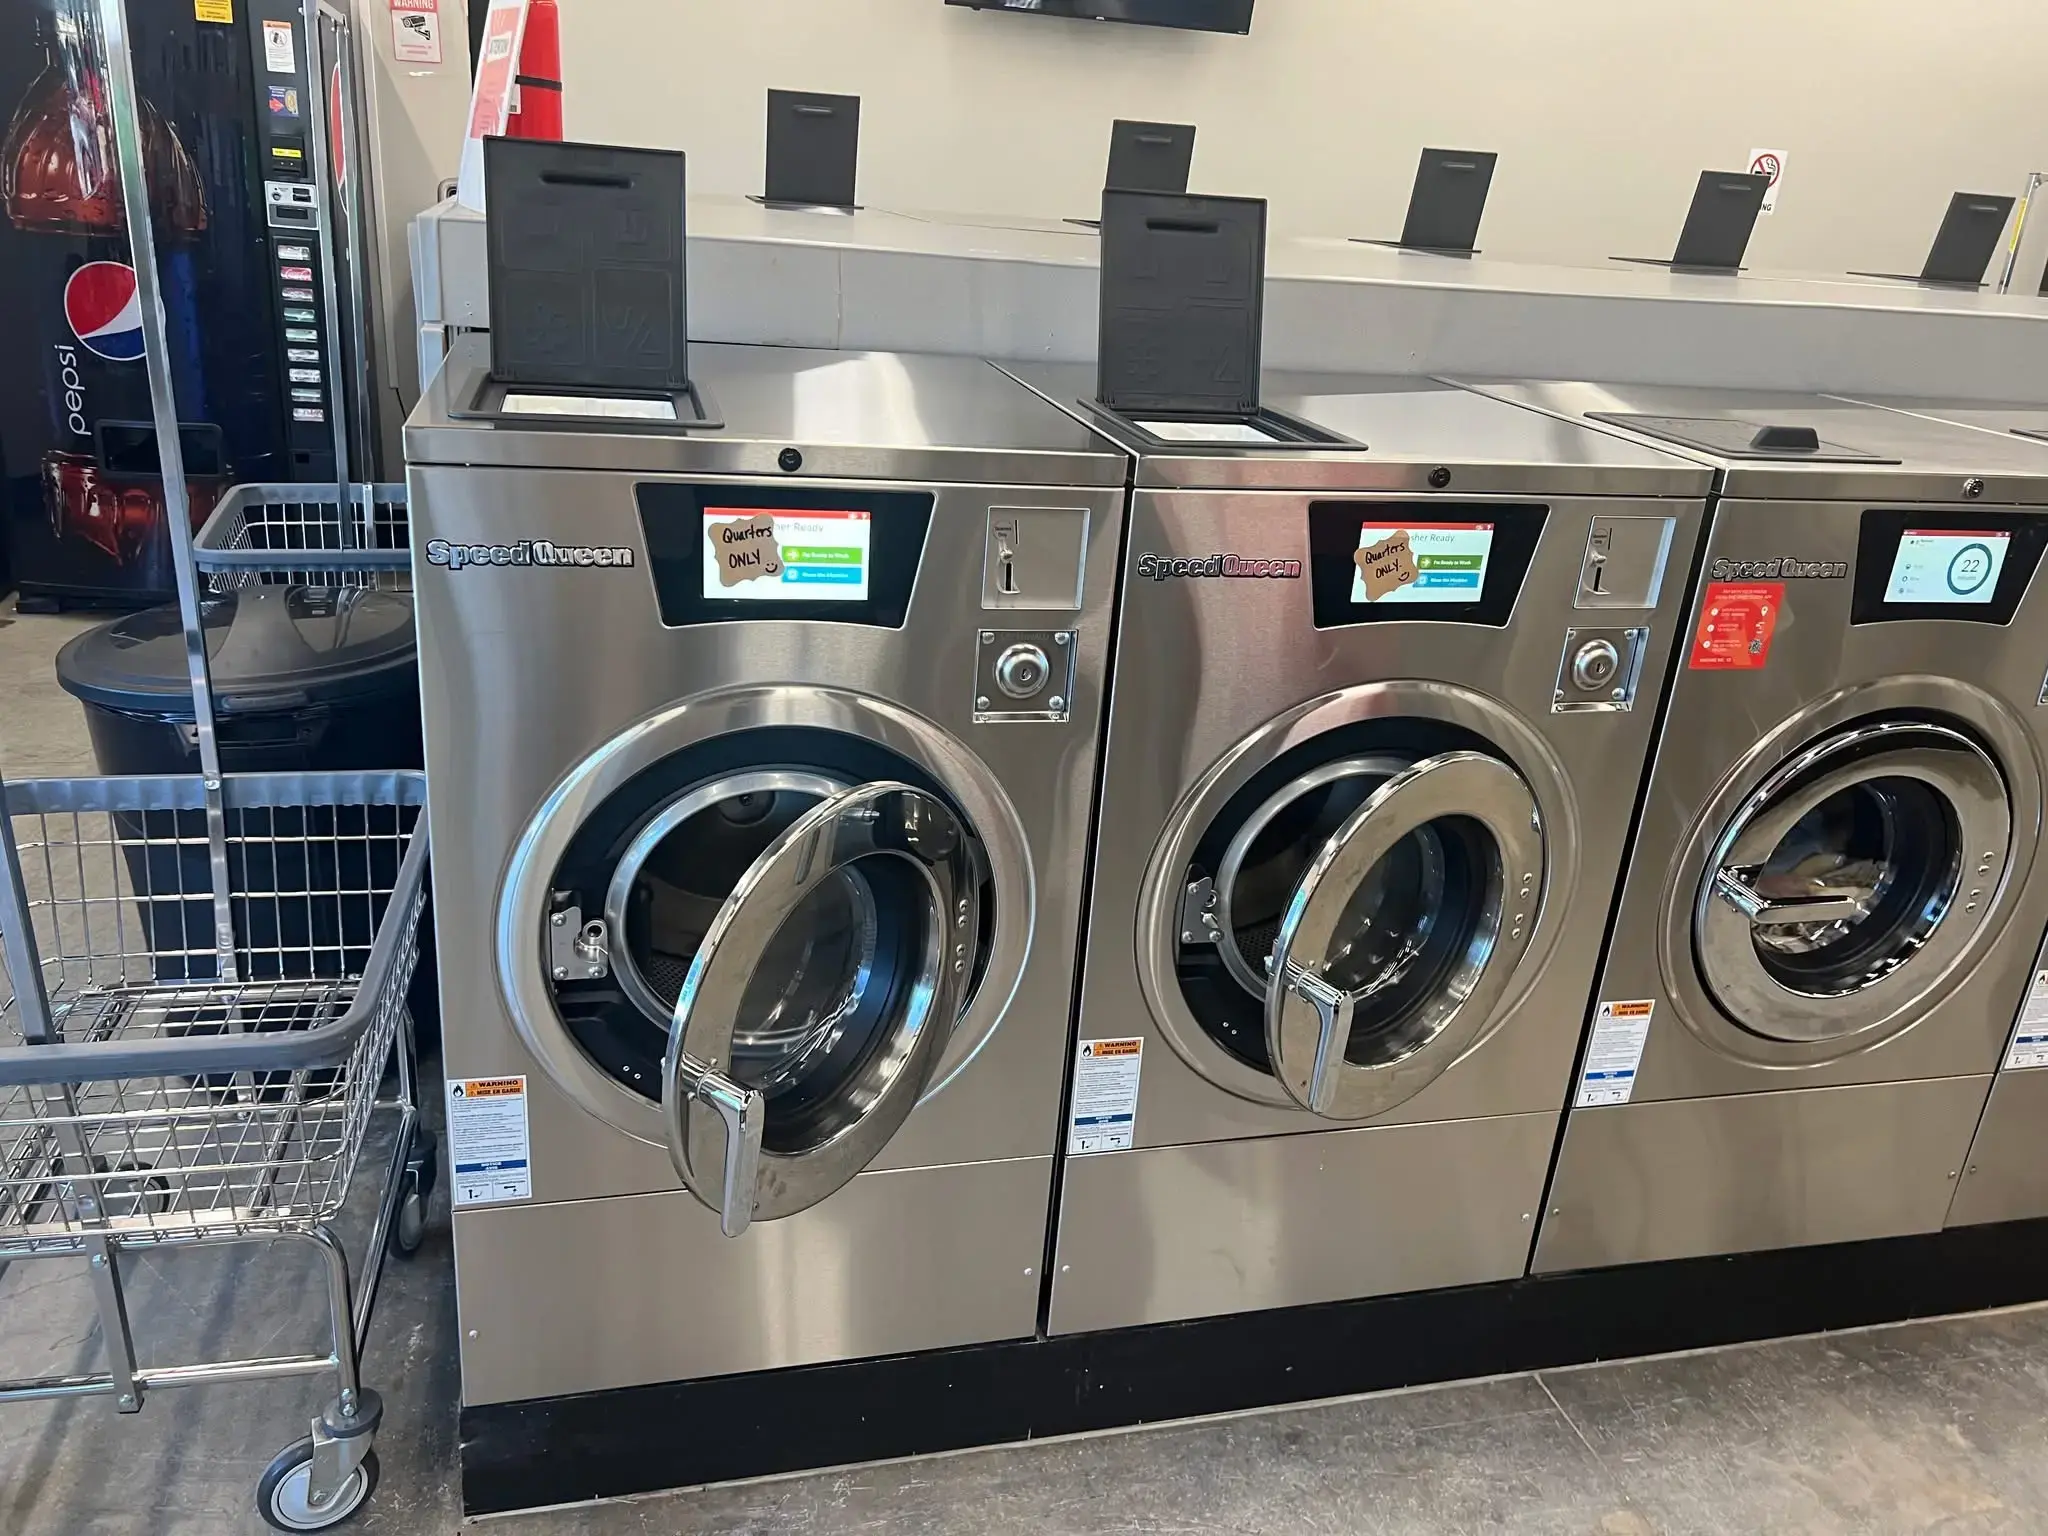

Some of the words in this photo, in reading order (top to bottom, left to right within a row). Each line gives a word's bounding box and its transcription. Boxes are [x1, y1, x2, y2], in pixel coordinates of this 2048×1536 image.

[54, 344, 92, 436] pepsi
[722, 524, 773, 544] Quarters
[1430, 533, 1456, 543] Ready
[426, 539, 532, 570] Speed
[532, 540, 635, 568] Queen
[728, 548, 761, 569] ONLY
[1365, 543, 1405, 564] Quarters
[1138, 553, 1221, 581] Speed
[1221, 553, 1302, 578] Queen
[1711, 557, 1782, 582] Speed
[1780, 557, 1849, 579] Queen
[1960, 559, 1981, 573] 22
[478, 1079, 519, 1088] WARNING
